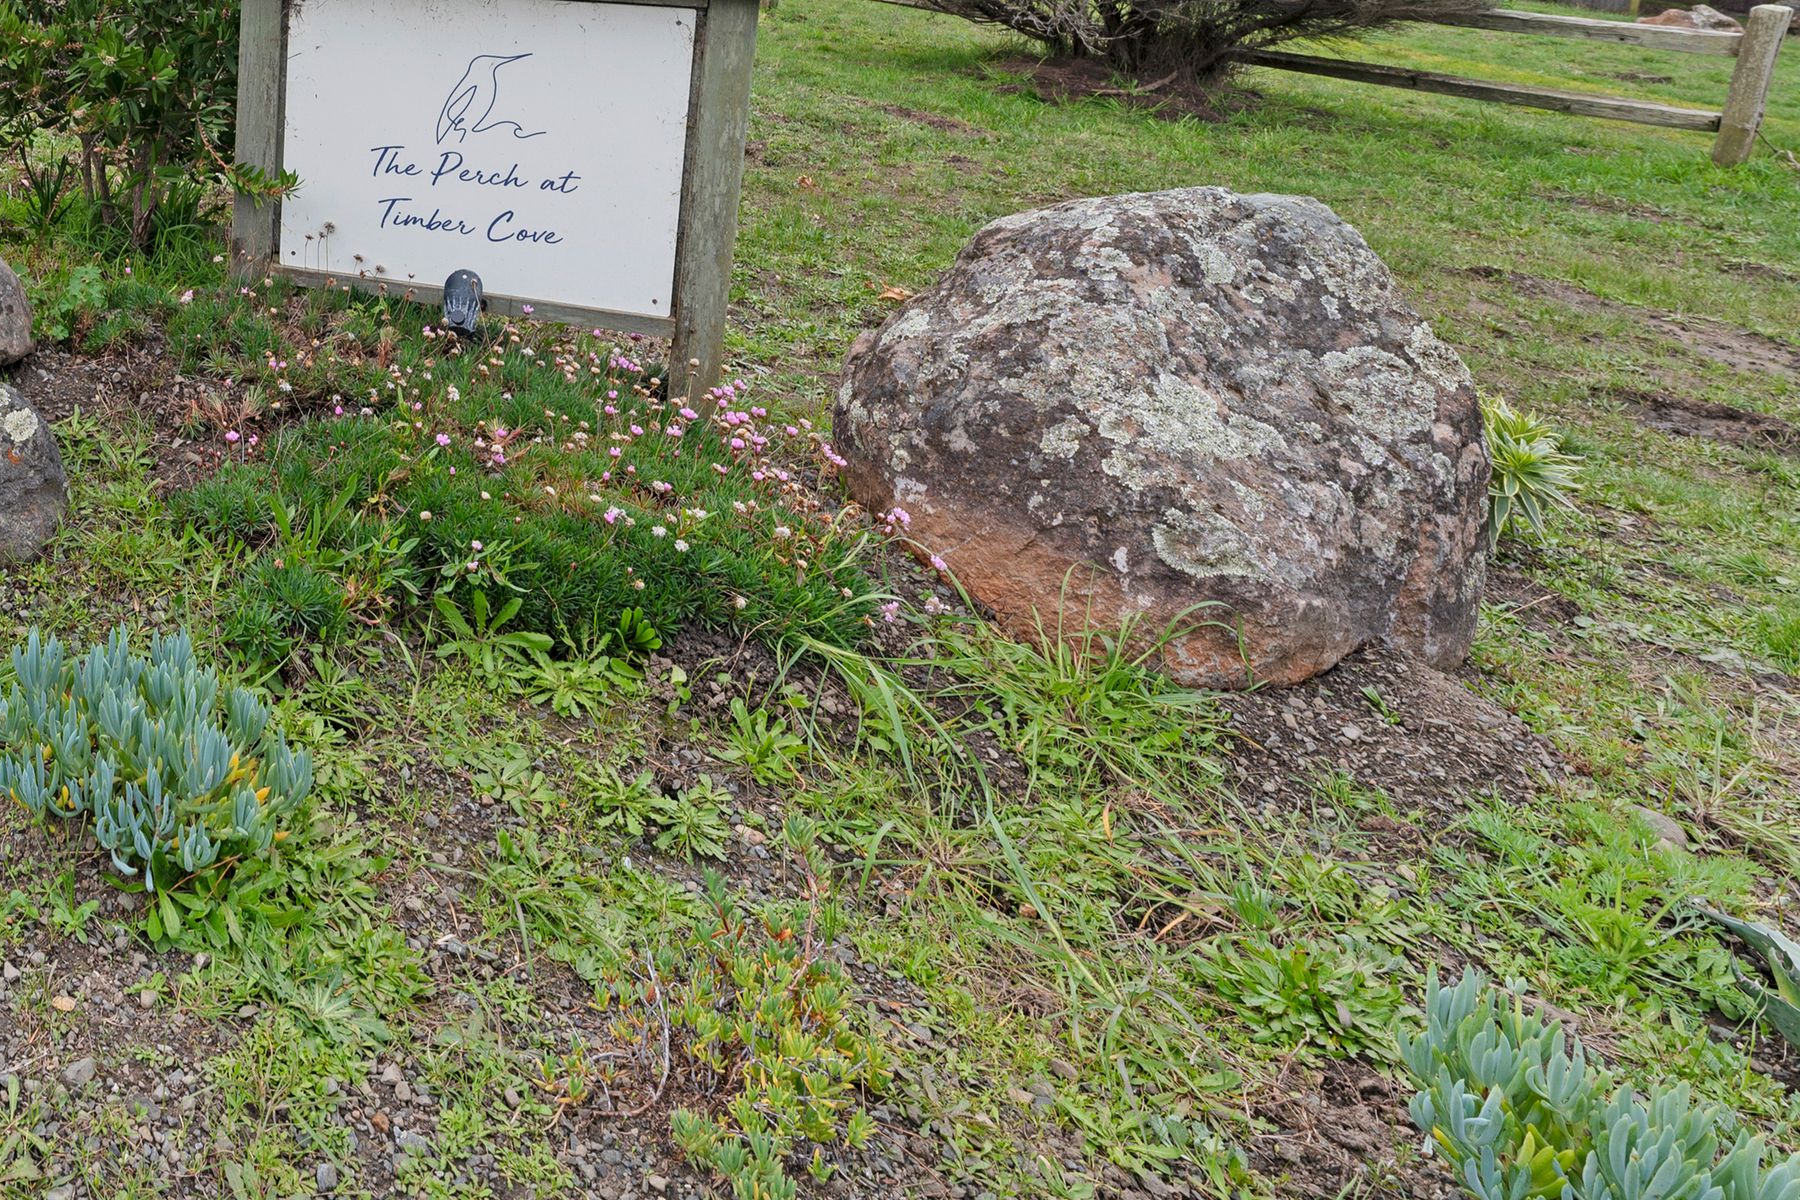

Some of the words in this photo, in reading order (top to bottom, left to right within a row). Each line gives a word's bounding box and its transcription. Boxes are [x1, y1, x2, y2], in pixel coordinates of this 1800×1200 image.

[370, 145, 423, 177] The
[430, 151, 529, 187] Perch
[539, 170, 582, 194] at
[377, 197, 476, 235] Timber
[486, 210, 564, 245] Cove
